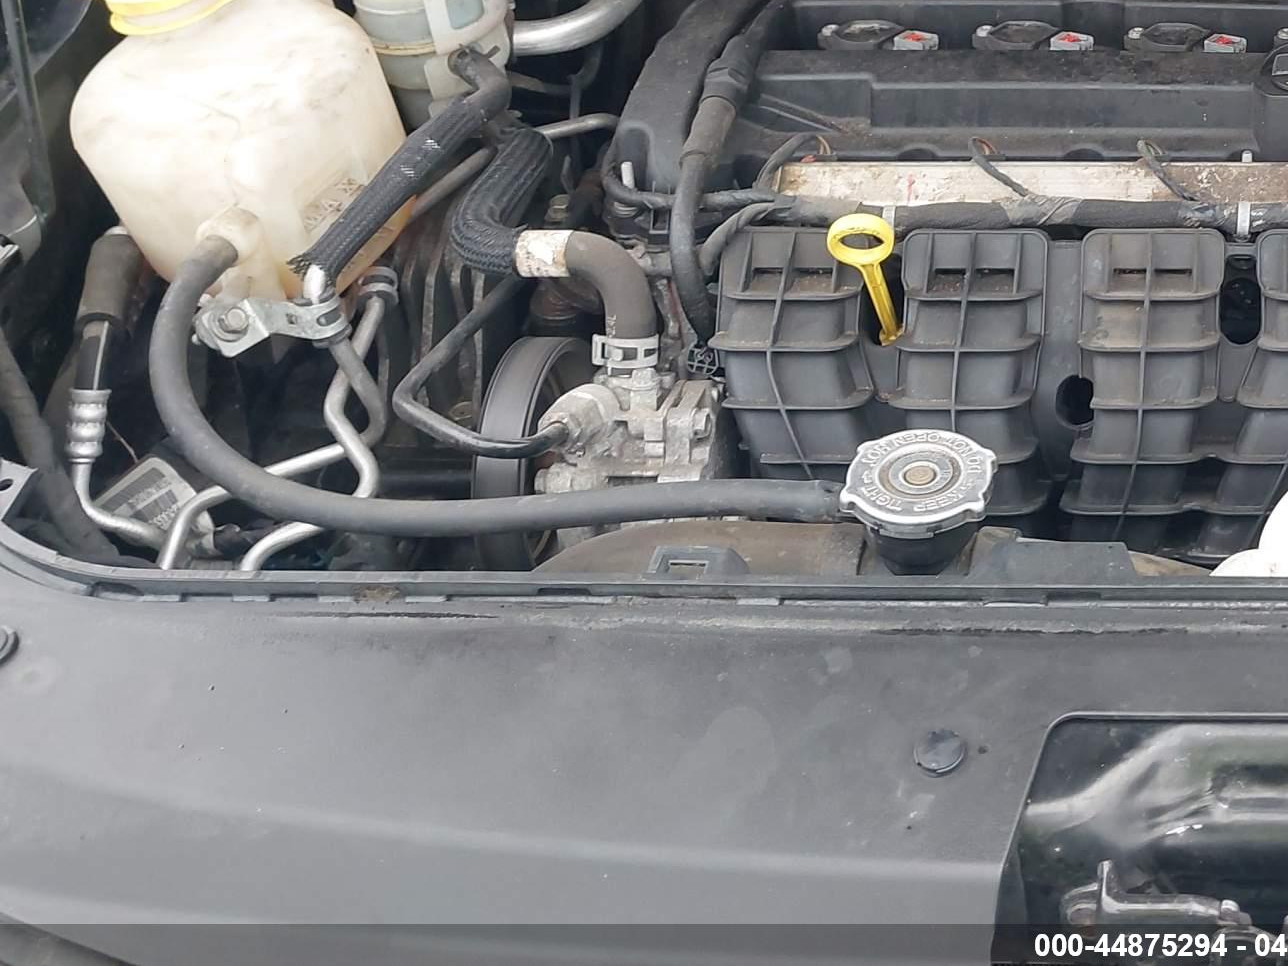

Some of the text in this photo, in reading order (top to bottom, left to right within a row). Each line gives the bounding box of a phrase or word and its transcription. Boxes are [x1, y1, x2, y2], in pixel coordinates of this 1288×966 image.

[860, 431, 983, 475] DO NOT OPEN HOT
[857, 485, 963, 512] KEEP TIGHT
